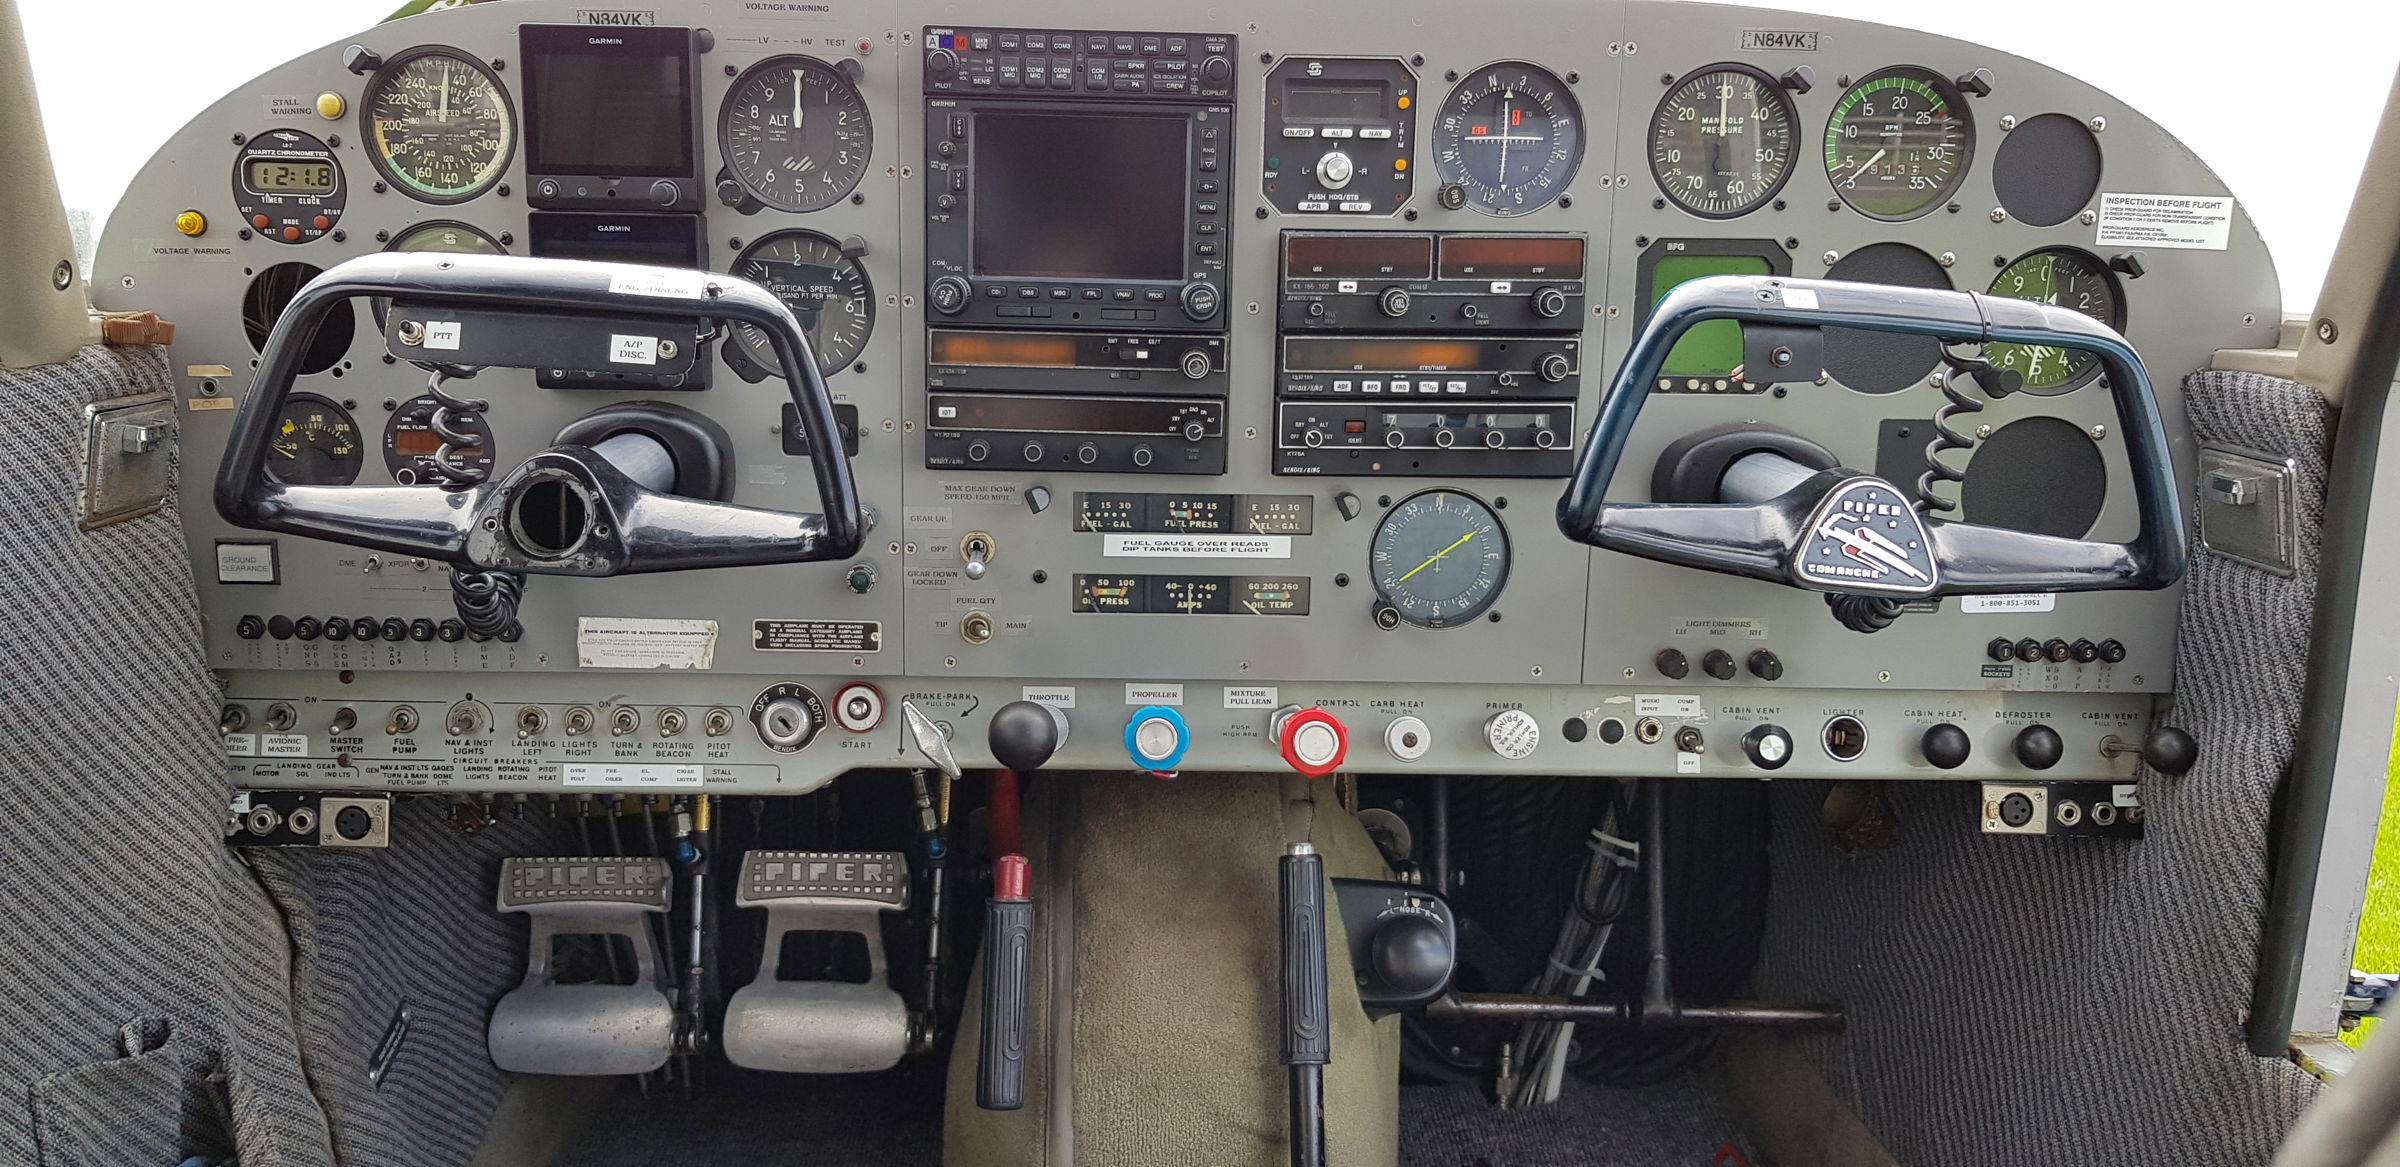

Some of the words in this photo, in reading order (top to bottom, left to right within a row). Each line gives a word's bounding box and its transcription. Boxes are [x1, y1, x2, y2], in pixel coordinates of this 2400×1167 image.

[745, 2, 786, 11] VOLTAGE
[789, 4, 829, 12] WARNING
[588, 12, 642, 25] N84VK
[1753, 35, 1806, 47] N84VK
[406, 78, 425, 89] 240
[453, 75, 466, 85] 40
[1489, 77, 1497, 86] N
[469, 87, 482, 98] 60
[1892, 97, 1908, 109] 20
[271, 108, 312, 116] WARNING
[1678, 108, 1695, 120] 20
[1751, 108, 1768, 121] 40
[1862, 103, 1874, 116] 15
[768, 115, 788, 127] ALT
[839, 112, 847, 125] 2
[1916, 112, 1932, 125] 25
[415, 167, 432, 178] 160
[441, 172, 458, 184] 140
[795, 179, 804, 192] 5
[2106, 197, 2155, 206] INSPECTION
[2157, 200, 2190, 208] BEFORE
[433, 332, 452, 340] PTT
[624, 340, 642, 348] A/P
[620, 350, 647, 359] DISC.
[965, 485, 987, 493] GEAR
[1844, 500, 1900, 516] PIPER
[1190, 520, 1219, 529] PRESS
[1808, 564, 1879, 579] COMANCHE
[980, 597, 995, 605] QTY
[1100, 597, 1129, 605] PRESS
[1251, 601, 1265, 609] OIL
[1269, 601, 1294, 609] TEMP
[1685, 620, 1710, 628] LIGHT
[1712, 620, 1751, 628] DIMMERS
[754, 693, 770, 713] OFF
[1400, 700, 1425, 708] HEAT
[806, 697, 824, 723] BOTH
[1938, 710, 1962, 718] HEAT
[525, 867, 644, 885] PIPER
[765, 863, 882, 882] PIPER
